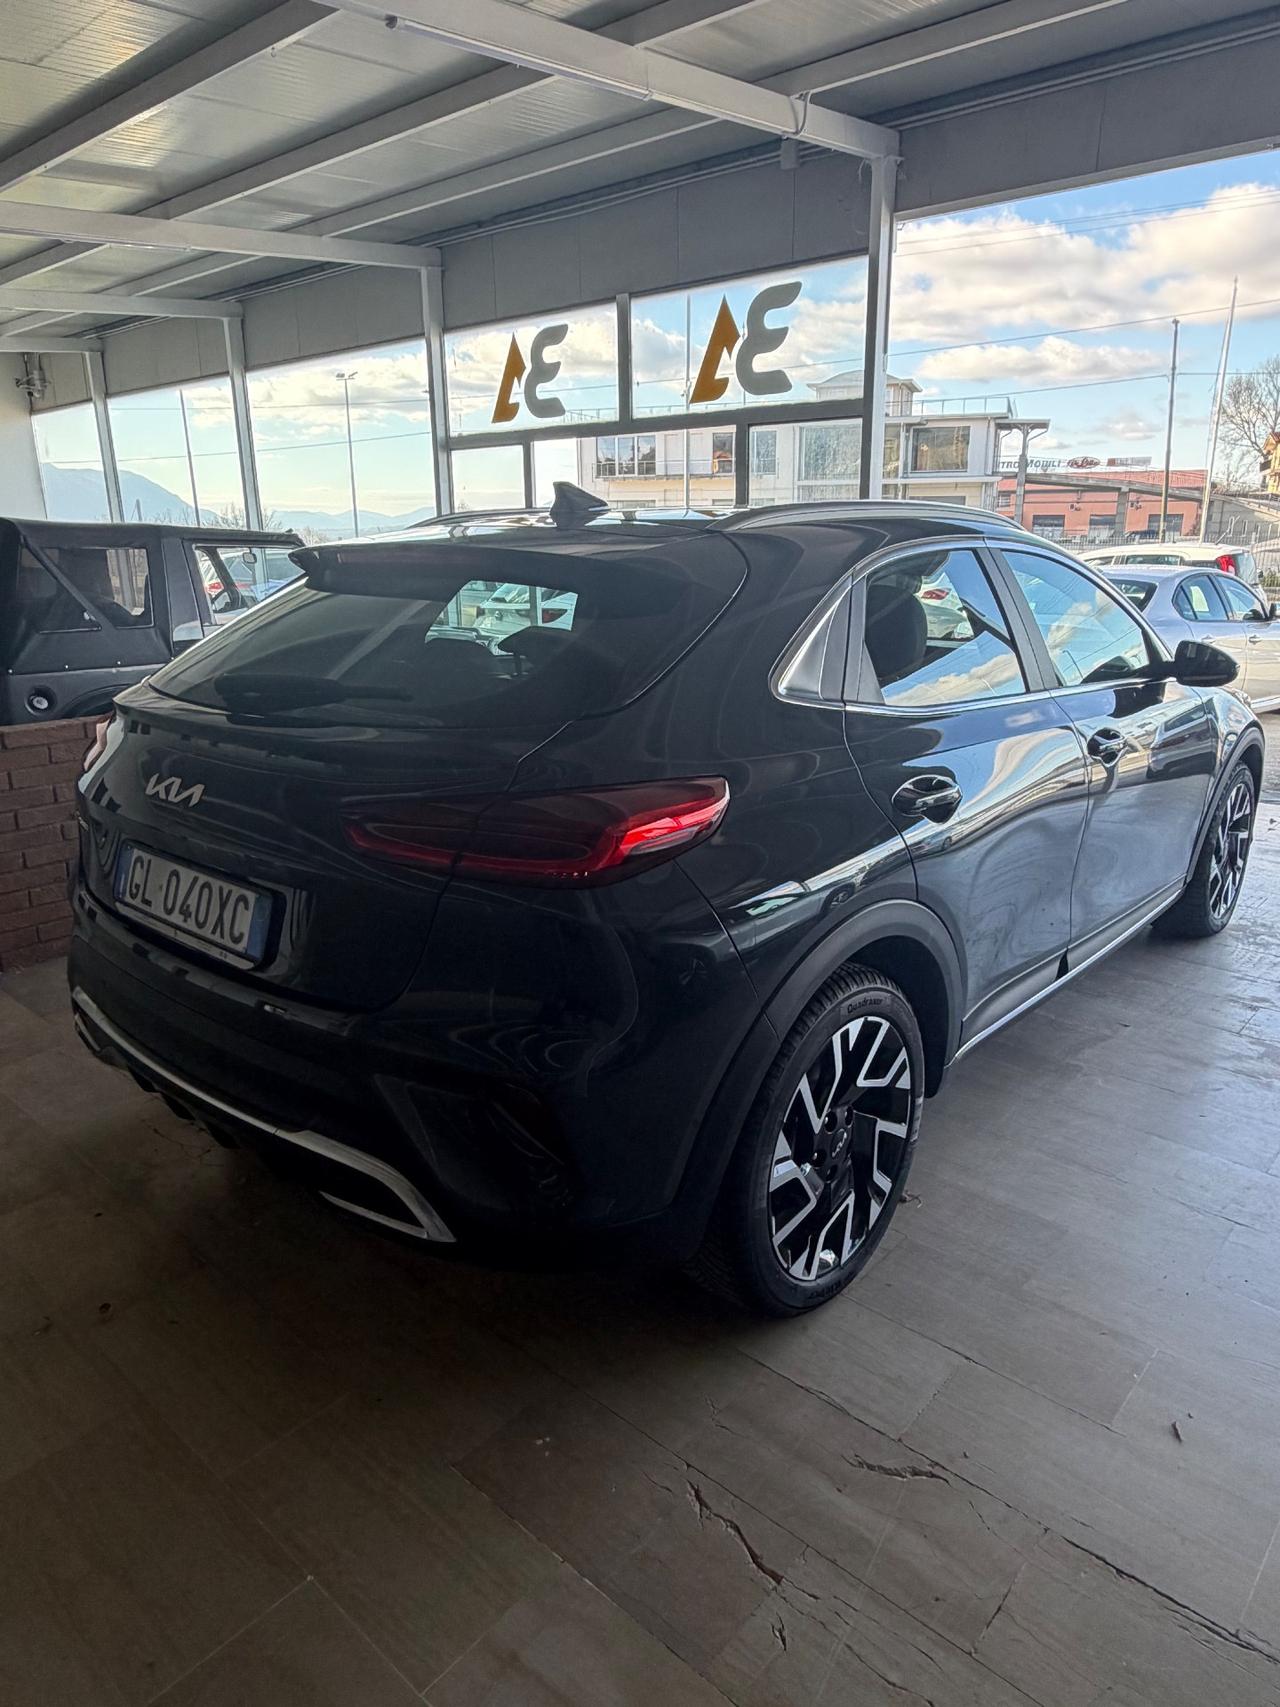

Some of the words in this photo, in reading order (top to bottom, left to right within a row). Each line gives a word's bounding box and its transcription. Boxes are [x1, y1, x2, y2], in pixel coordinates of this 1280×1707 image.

[145, 773, 205, 807] KIA
[128, 855, 152, 908] GL
[163, 869, 249, 945] 040XC
